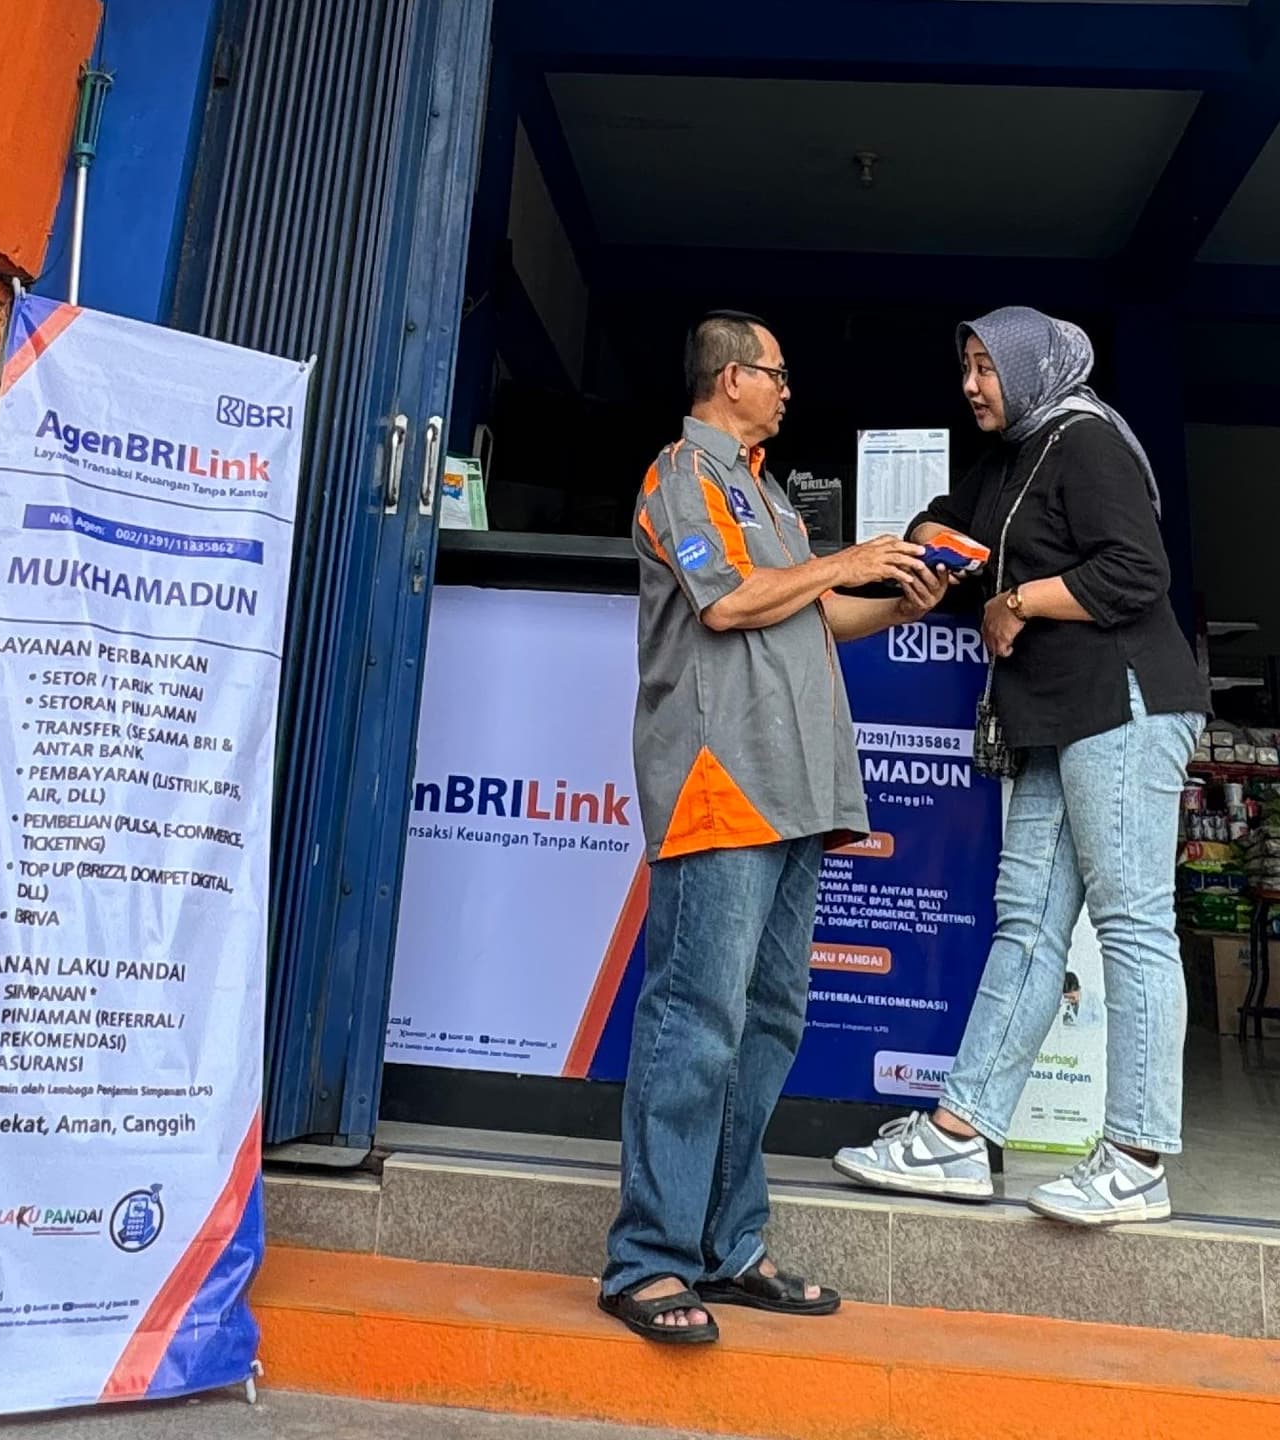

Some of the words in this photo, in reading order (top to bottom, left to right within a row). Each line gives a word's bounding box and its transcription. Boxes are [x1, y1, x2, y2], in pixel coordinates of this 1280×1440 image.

[246, 403, 293, 430] BRI
[35, 409, 271, 482] AgenBRILink
[34, 446, 81, 467] Layanan
[82, 459, 133, 480] Transaksi
[135, 471, 191, 492] Keuangan
[192, 481, 226, 499] Tanpa
[228, 486, 269, 500] Kantor
[7, 556, 258, 616] MUKHAMADUN
[98, 643, 209, 674] PERBANKAN
[42, 670, 97, 686] SETOR
[110, 676, 153, 695] TARIK
[159, 682, 205, 702] TUNAI
[38, 695, 116, 713] SETORAN
[122, 700, 198, 724] PINJAMAN
[35, 720, 122, 738] TRANSFER
[126, 723, 189, 749] (SESAMA
[193, 735, 218, 751] BRI
[222, 738, 234, 752] &
[32, 742, 94, 758] ANTAR
[99, 744, 145, 760] BANK
[28, 766, 149, 786] PEMBAYARAN
[27, 788, 62, 805] AIR,
[67, 788, 106, 806] DLL)
[879, 792, 934, 807] Canggih
[23, 813, 112, 830] PEMBELIAN
[114, 815, 162, 838] (PULSA,
[22, 835, 106, 854] TICKETING)
[457, 826, 529, 848] Keuangan
[532, 832, 576, 851] Tanpa
[579, 835, 630, 853] Kantor
[19, 860, 50, 877] TOP
[52, 862, 75, 877] UP
[131, 866, 189, 886] DOMPET
[17, 883, 50, 902] DLL)
[880, 885, 914, 897] ANTAR
[14, 907, 60, 927] BRIVA
[828, 916, 869, 929] DOMPET
[838, 952, 884, 967] PANDAI
[57, 958, 110, 979] LAKU
[116, 961, 186, 983] PANDAI
[3, 984, 87, 1003] SIMPANAN
[0, 1008, 92, 1026] PINJAMAN
[94, 1009, 176, 1030] (REFERRAL
[0, 1032, 128, 1053] REKOMENDASI)
[1055, 1069, 1092, 1084] depan
[55, 1114, 117, 1136] Aman,
[122, 1113, 197, 1137] Canggih
[43, 1208, 104, 1225] PANDAI
